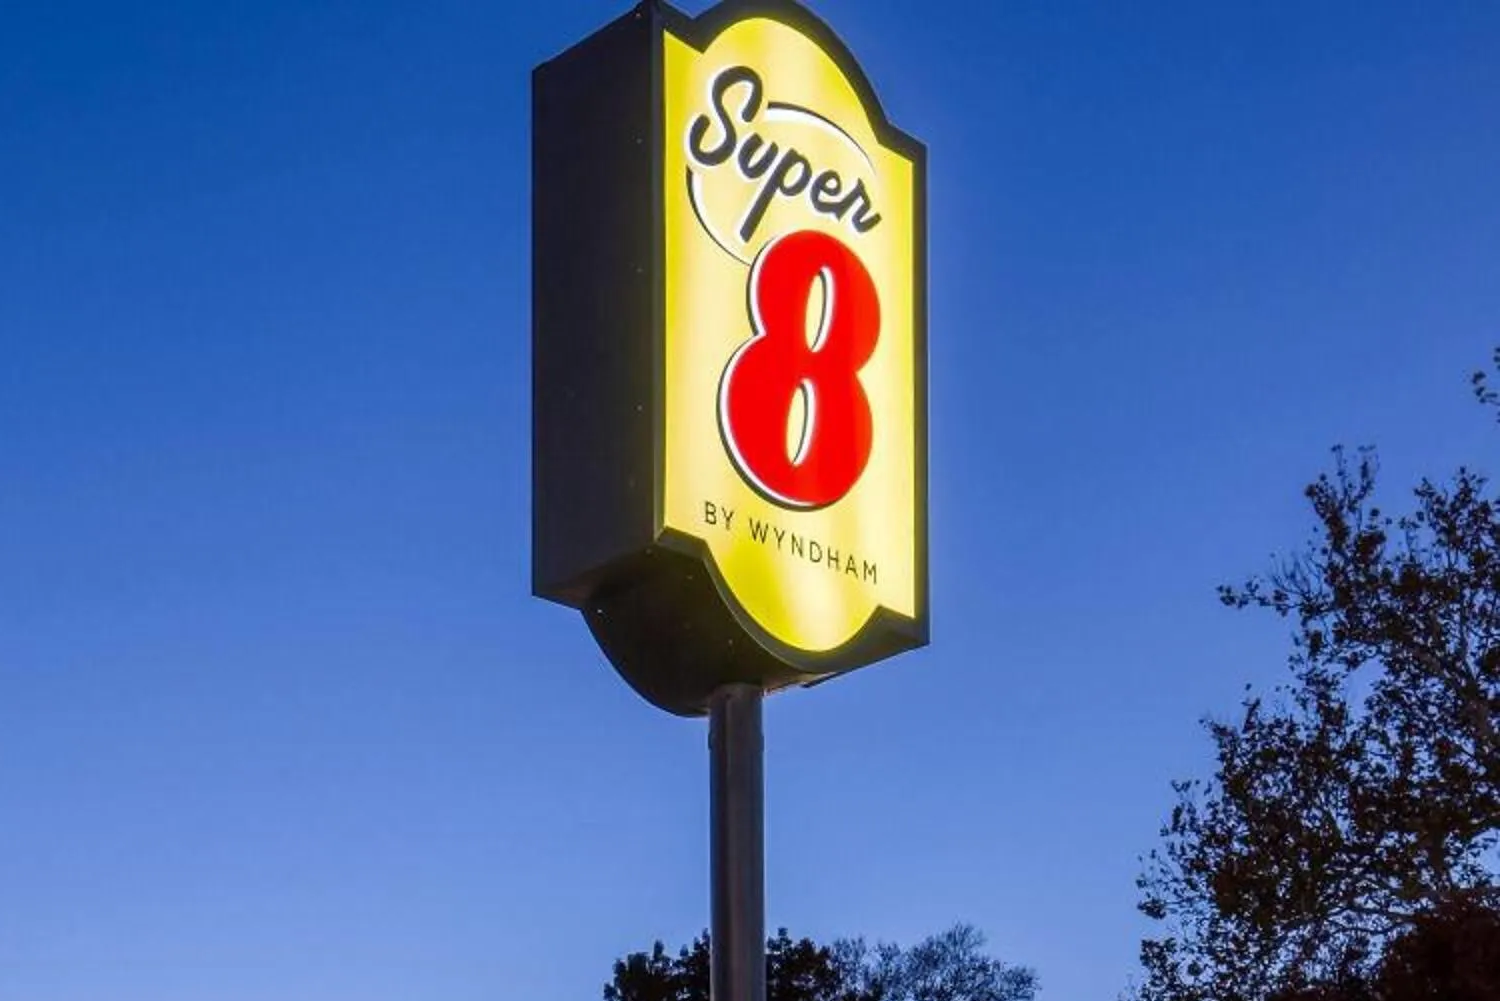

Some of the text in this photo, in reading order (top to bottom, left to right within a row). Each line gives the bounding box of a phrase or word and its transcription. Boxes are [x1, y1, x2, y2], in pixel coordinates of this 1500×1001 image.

[688, 65, 881, 242] Super
[716, 230, 881, 511] 8
[704, 502, 878, 585] BY WYNDHAM
